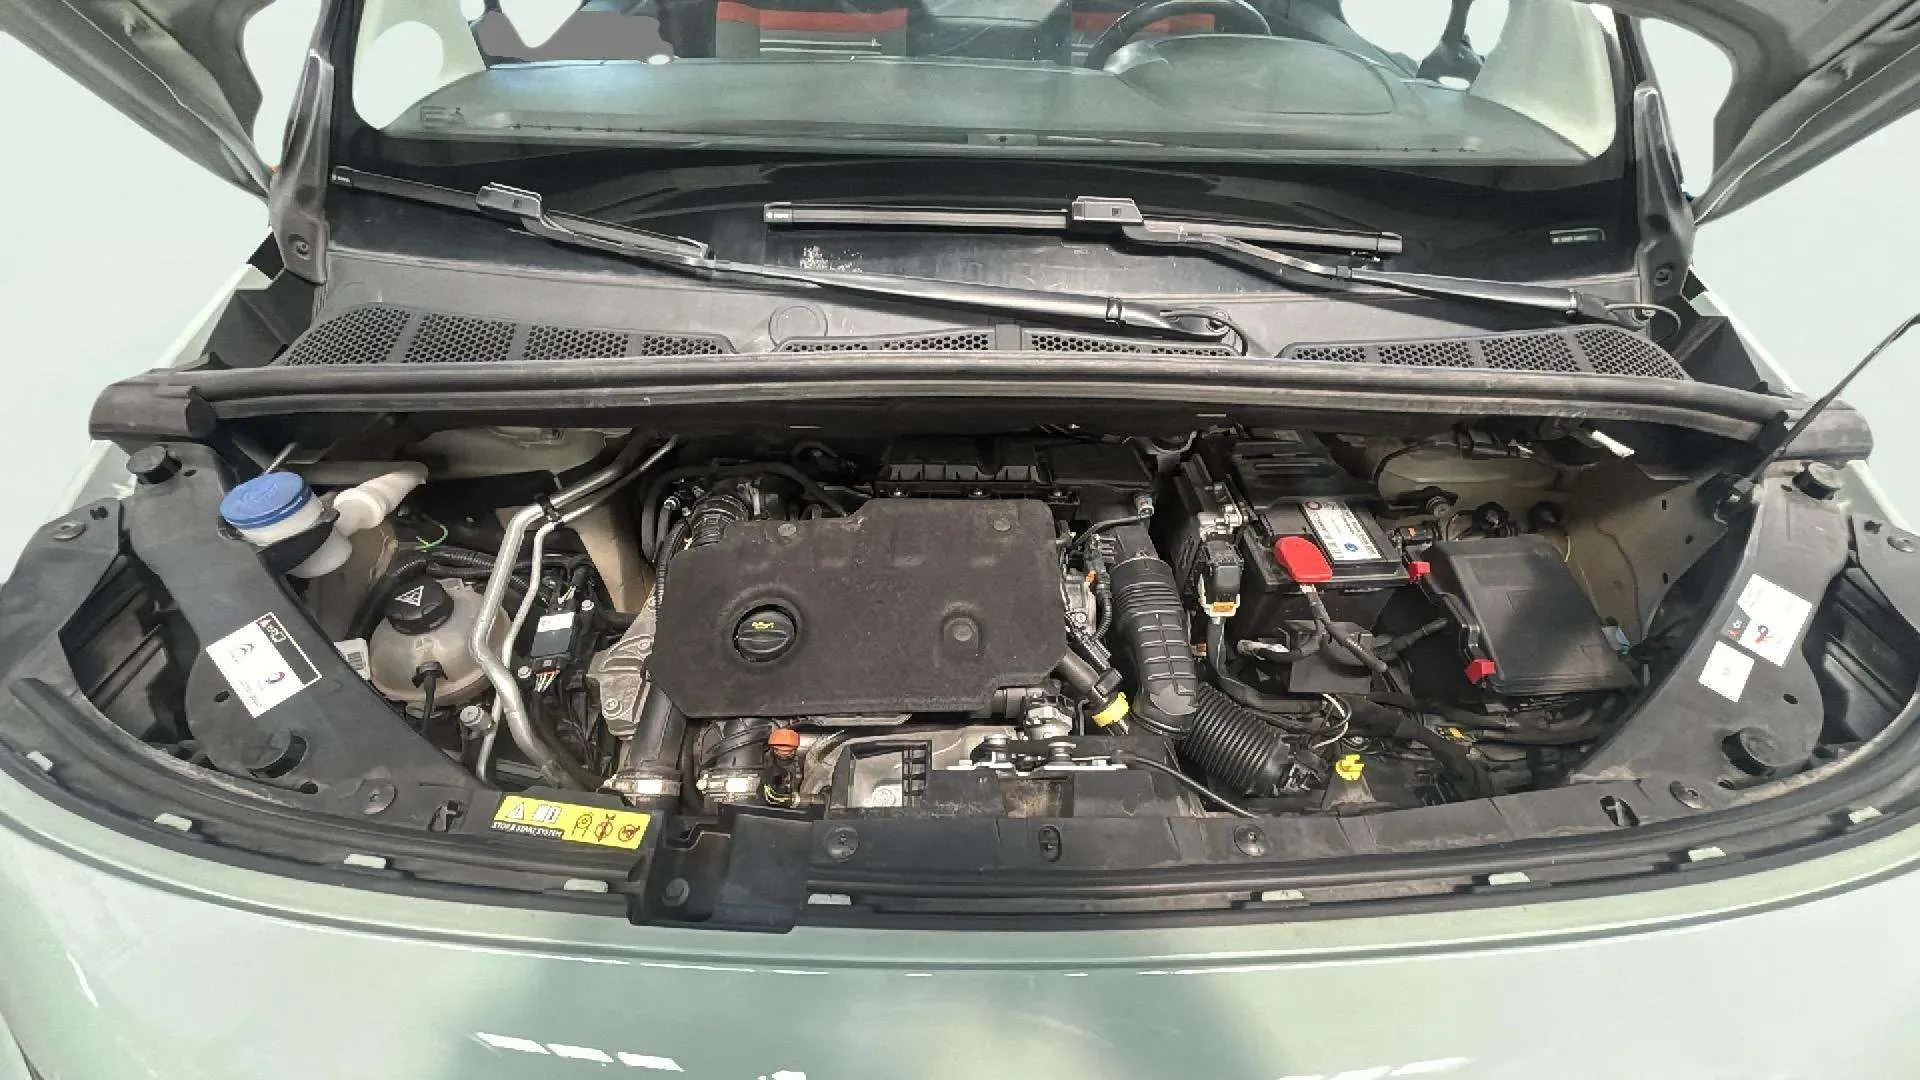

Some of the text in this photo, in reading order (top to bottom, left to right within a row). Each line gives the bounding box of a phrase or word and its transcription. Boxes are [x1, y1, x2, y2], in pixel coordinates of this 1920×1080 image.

[492, 821, 510, 830] STOP
[516, 825, 535, 835] START
[536, 828, 562, 837] SYSTEM
